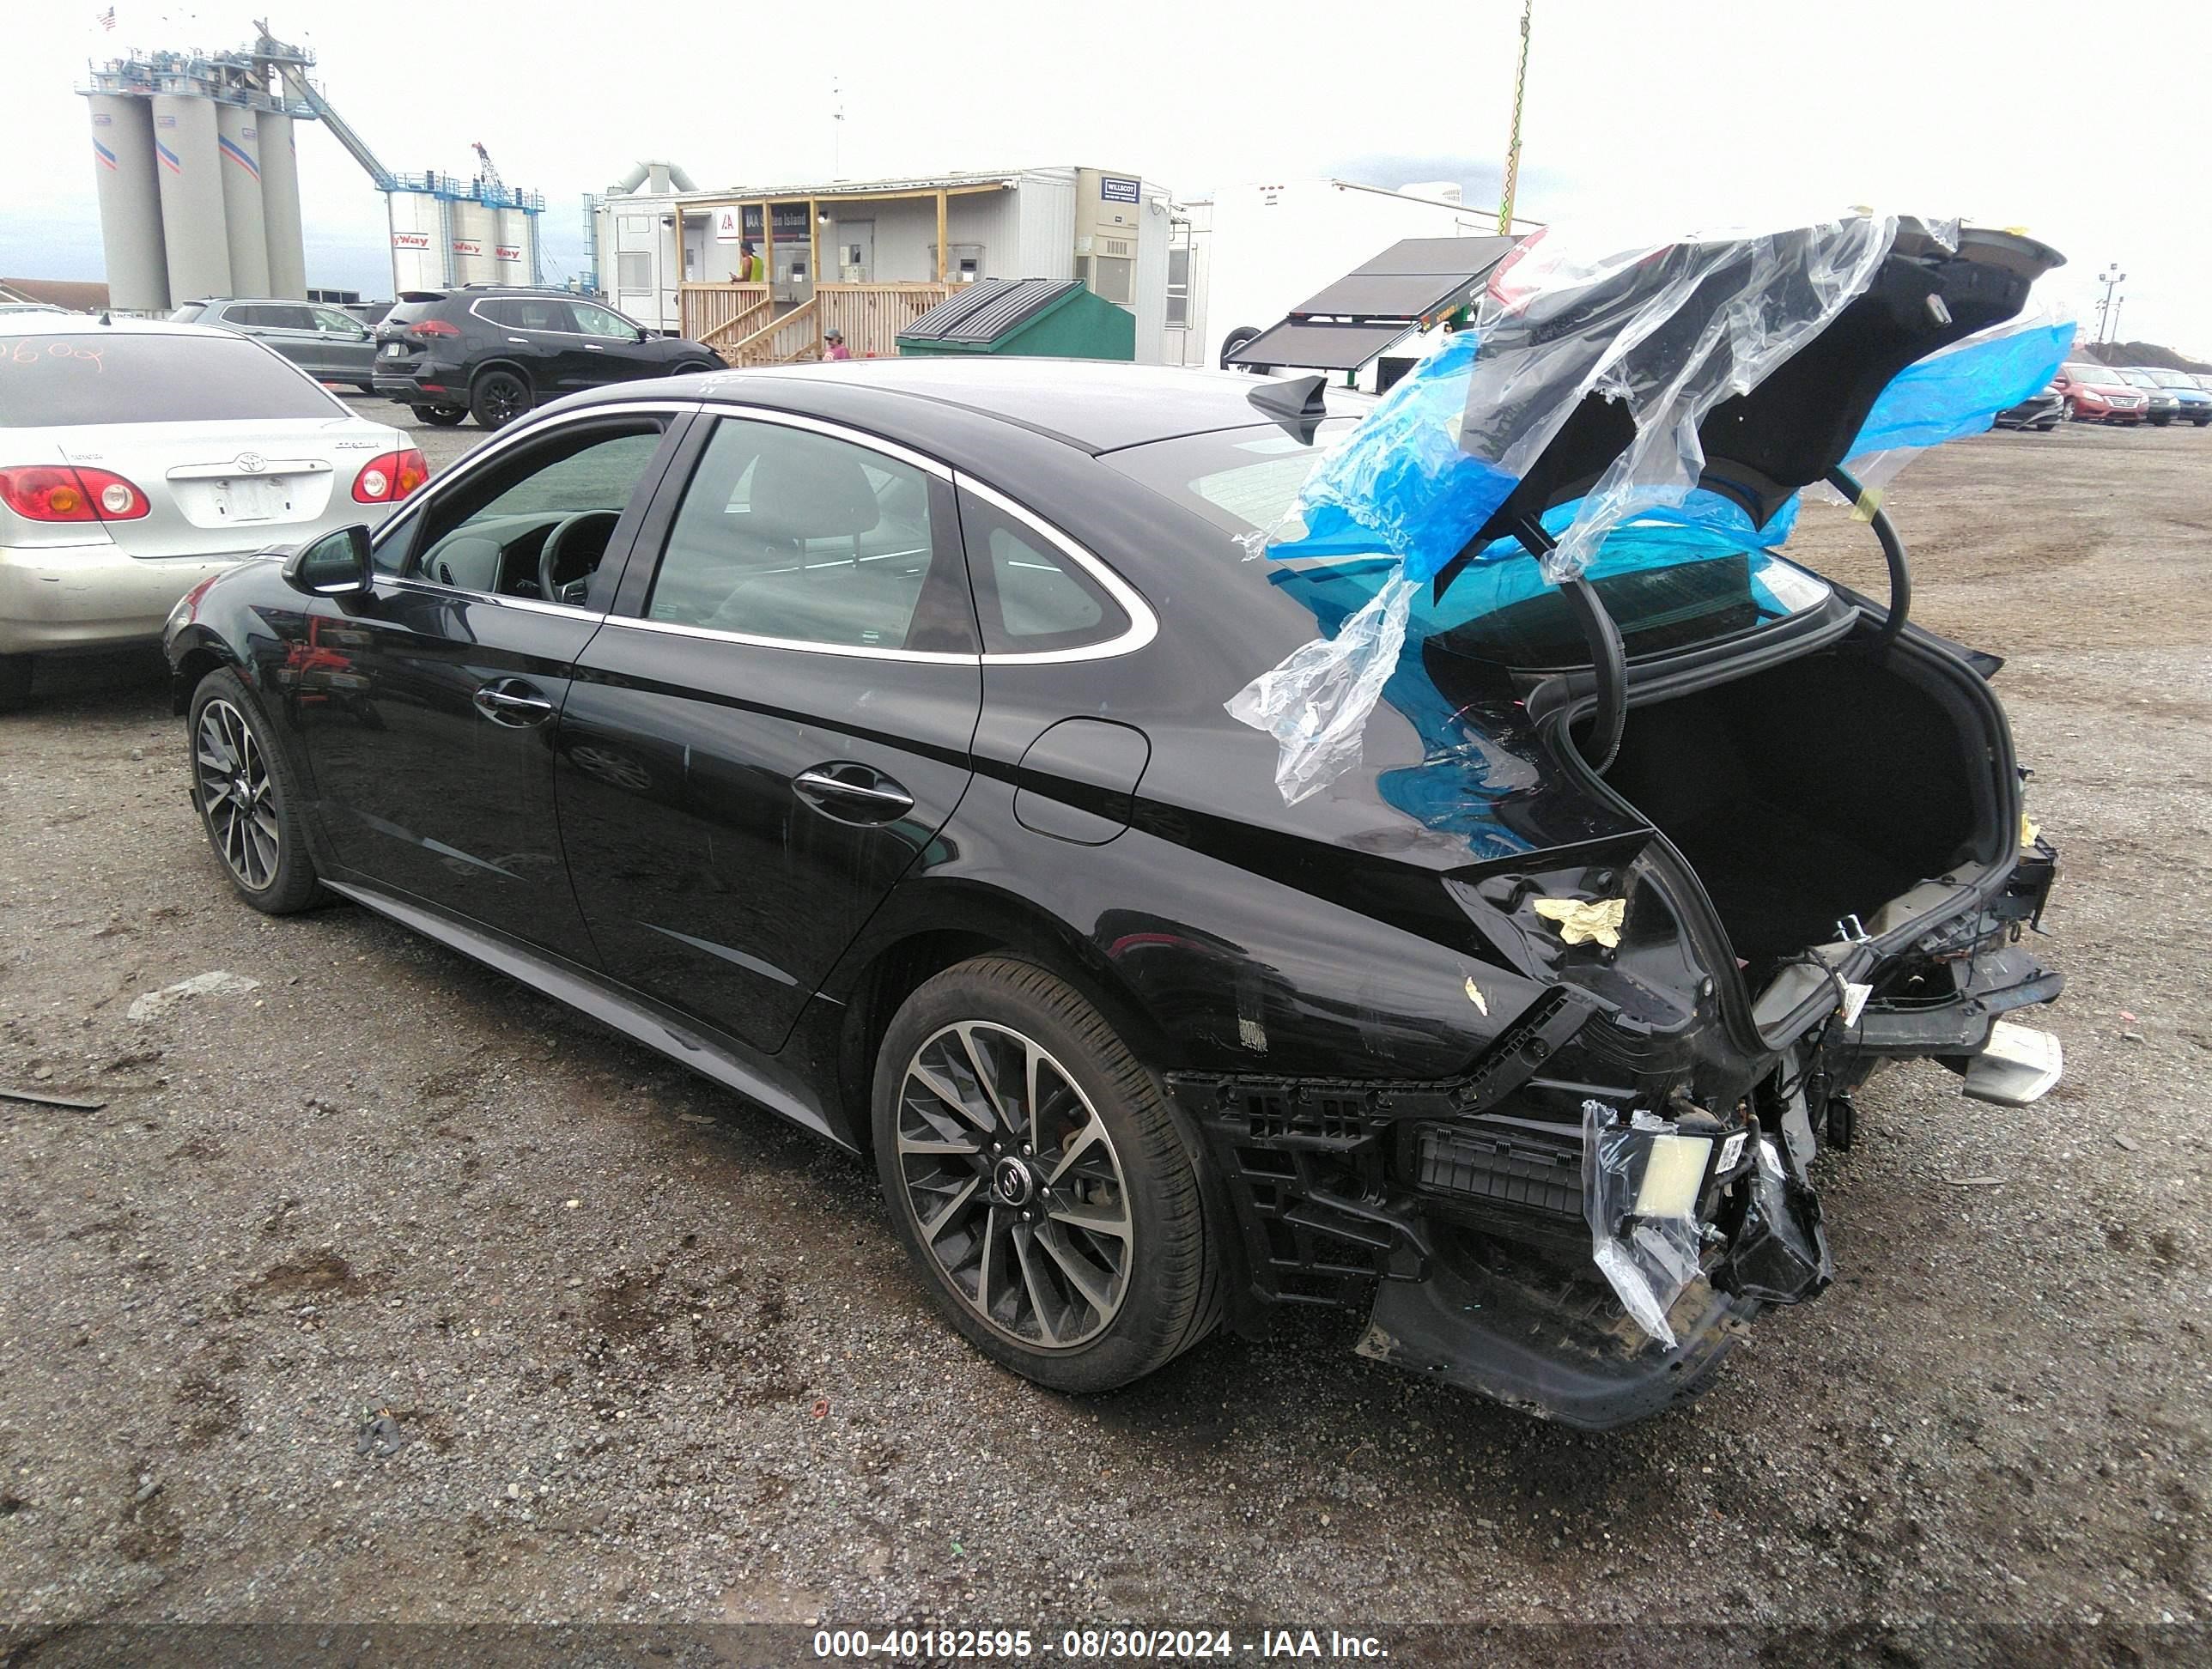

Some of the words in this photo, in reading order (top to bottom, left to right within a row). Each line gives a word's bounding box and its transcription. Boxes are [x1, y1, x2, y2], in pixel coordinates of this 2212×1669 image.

[1108, 184, 1134, 192] WILLSCOT
[746, 215, 760, 228] IAA
[783, 212, 806, 227] Island
